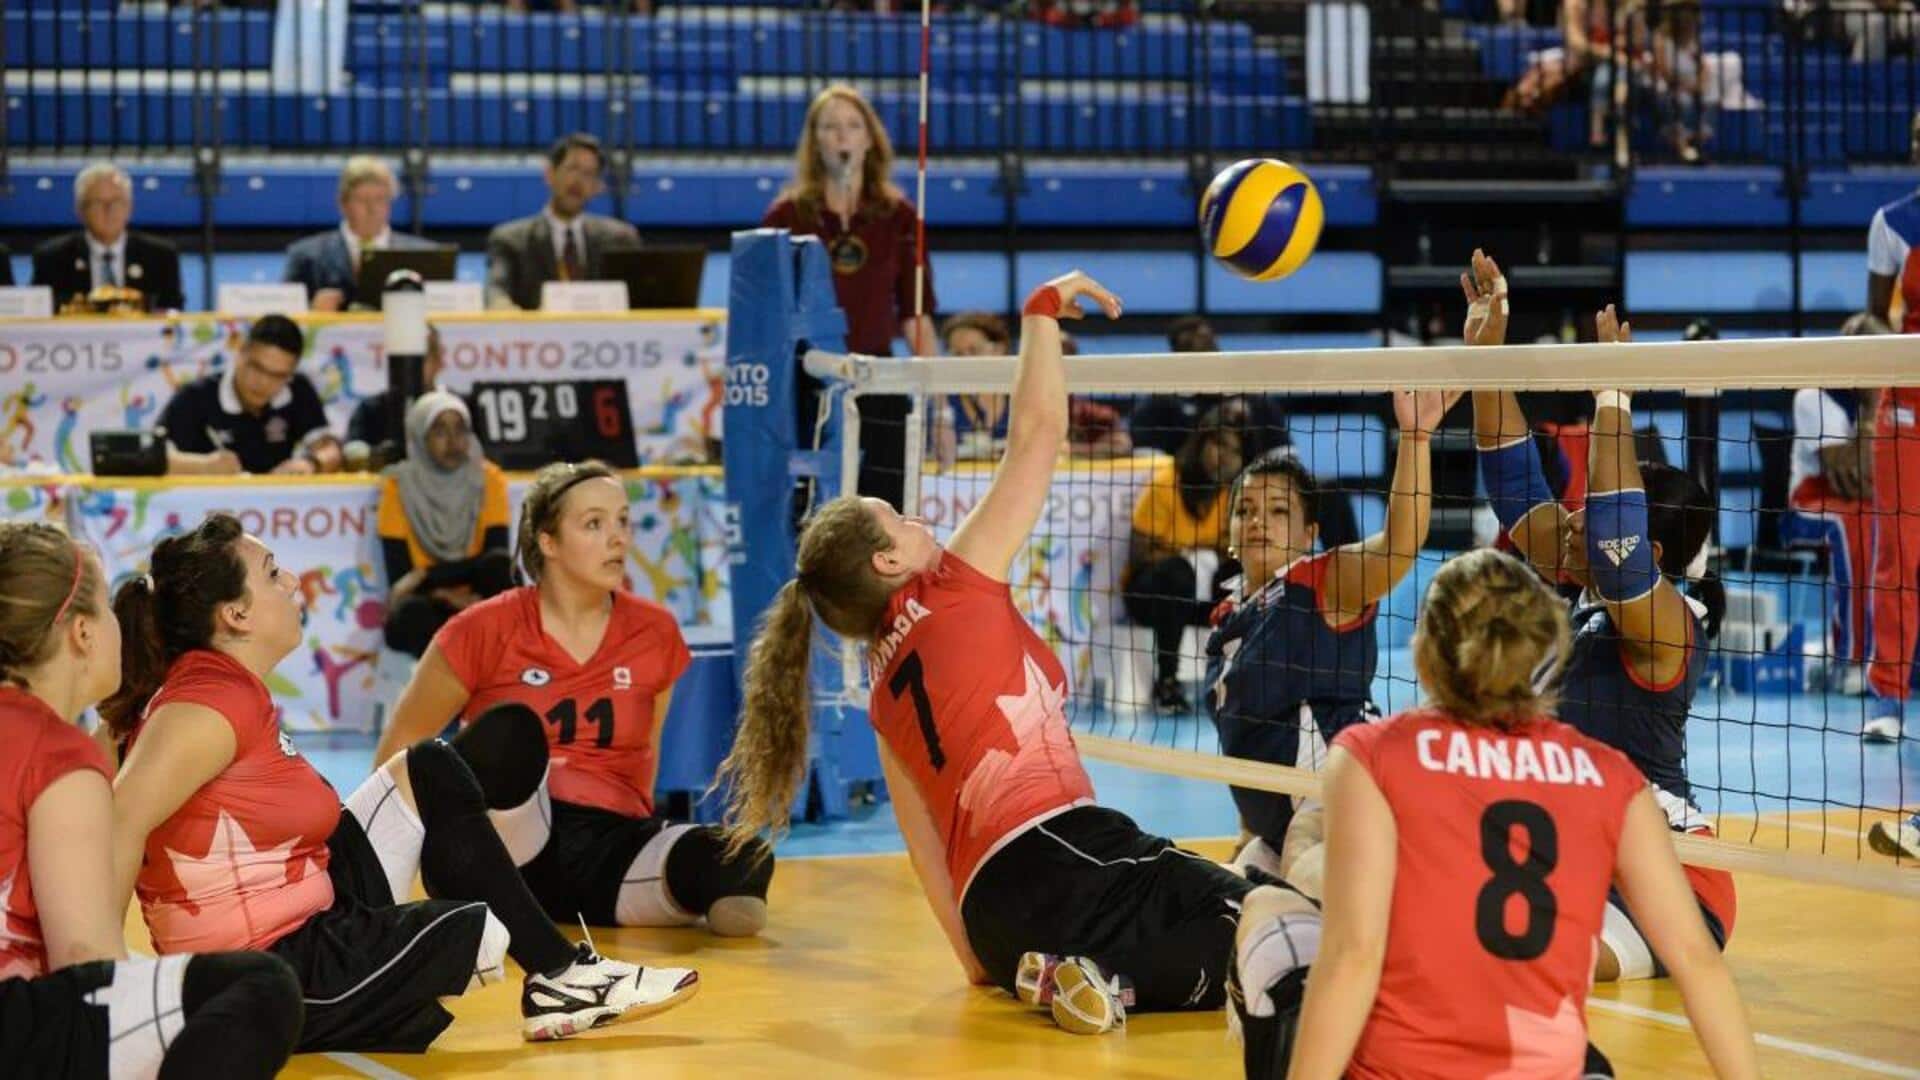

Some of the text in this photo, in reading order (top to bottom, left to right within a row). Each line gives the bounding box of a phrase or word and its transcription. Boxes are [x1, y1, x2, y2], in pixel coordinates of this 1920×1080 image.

[24, 342, 124, 373] 2015
[571, 340, 662, 370] 2015
[478, 383, 622, 442] 19 2 0 6
[545, 696, 615, 749] 11
[889, 649, 946, 774] 7
[1416, 729, 1604, 788] CANADA
[1475, 799, 1558, 961] 8
